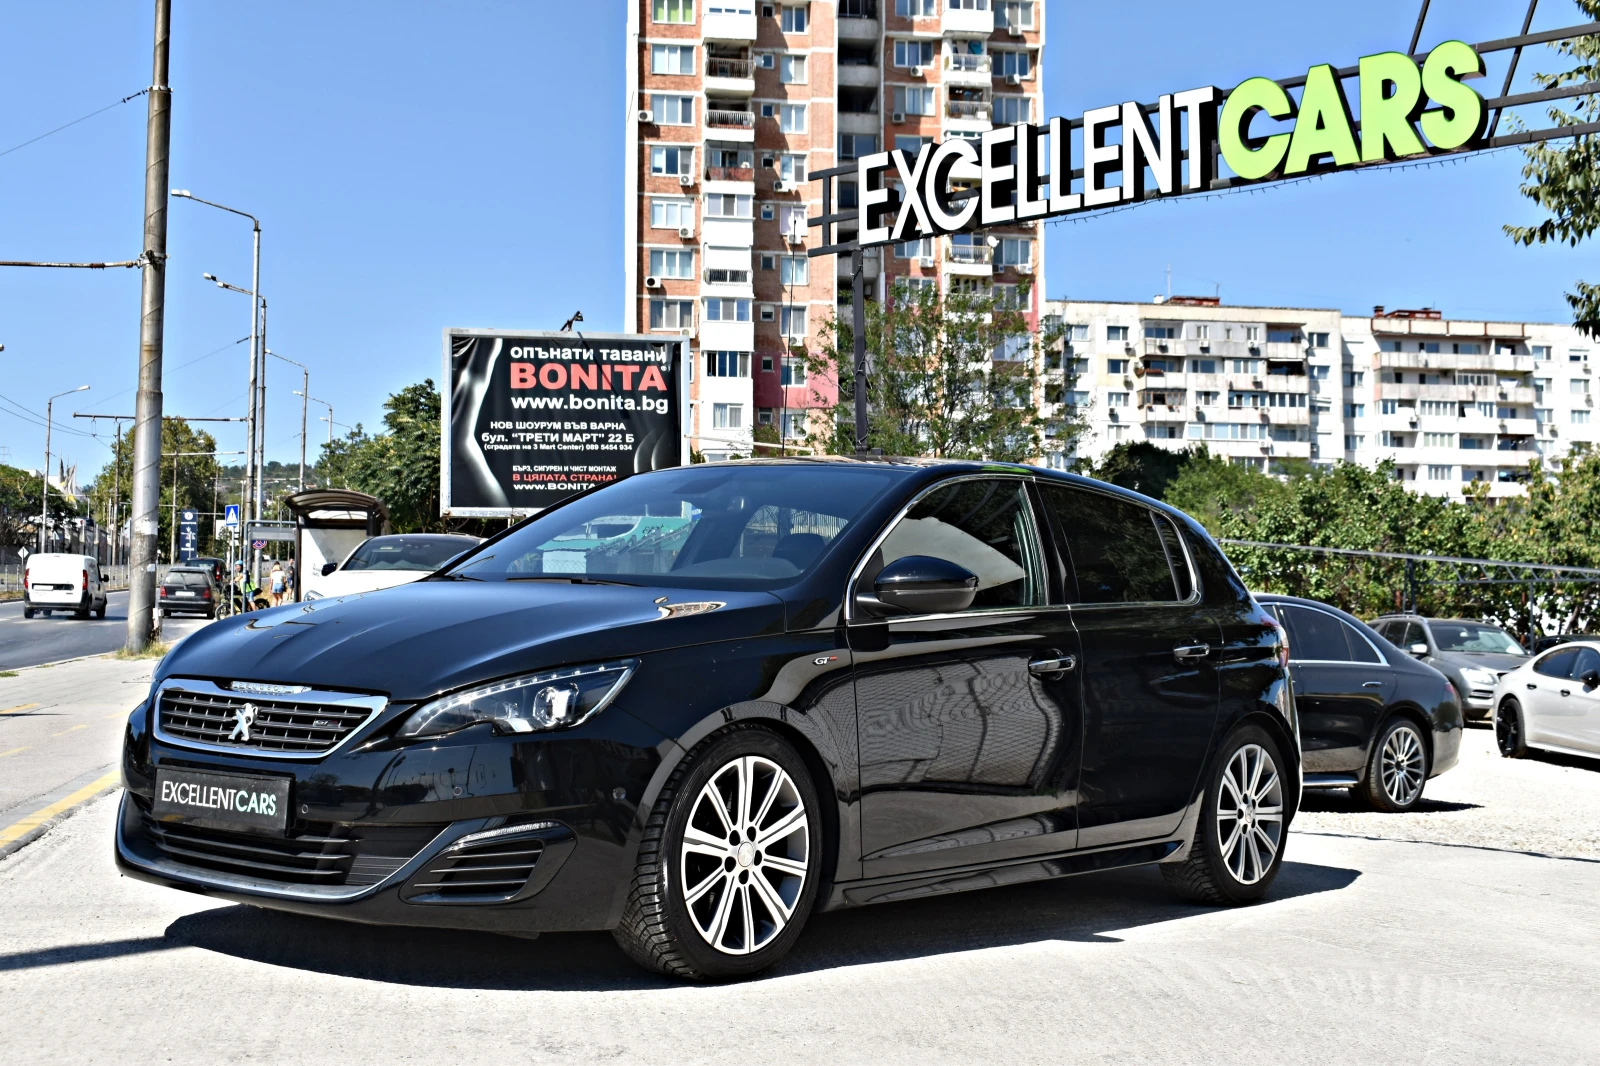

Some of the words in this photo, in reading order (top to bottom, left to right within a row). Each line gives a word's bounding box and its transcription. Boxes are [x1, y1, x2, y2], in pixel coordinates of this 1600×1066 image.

[510, 346, 594, 360] опънати
[599, 348, 665, 363] тавани
[511, 394, 669, 414] www.bonita.bg
[490, 421, 513, 429] НОВ
[515, 421, 562, 430] ШОУРУМ
[564, 421, 588, 430] ВЪВ
[590, 422, 627, 430] ВАРНА
[481, 432, 509, 444] бул.
[607, 433, 622, 443] 22
[625, 433, 635, 443] Б
[484, 443, 520, 451] (сградата
[557, 443, 584, 451] Center)
[512, 473, 521, 481] В
[523, 473, 567, 482] ЦЯЛАТА
